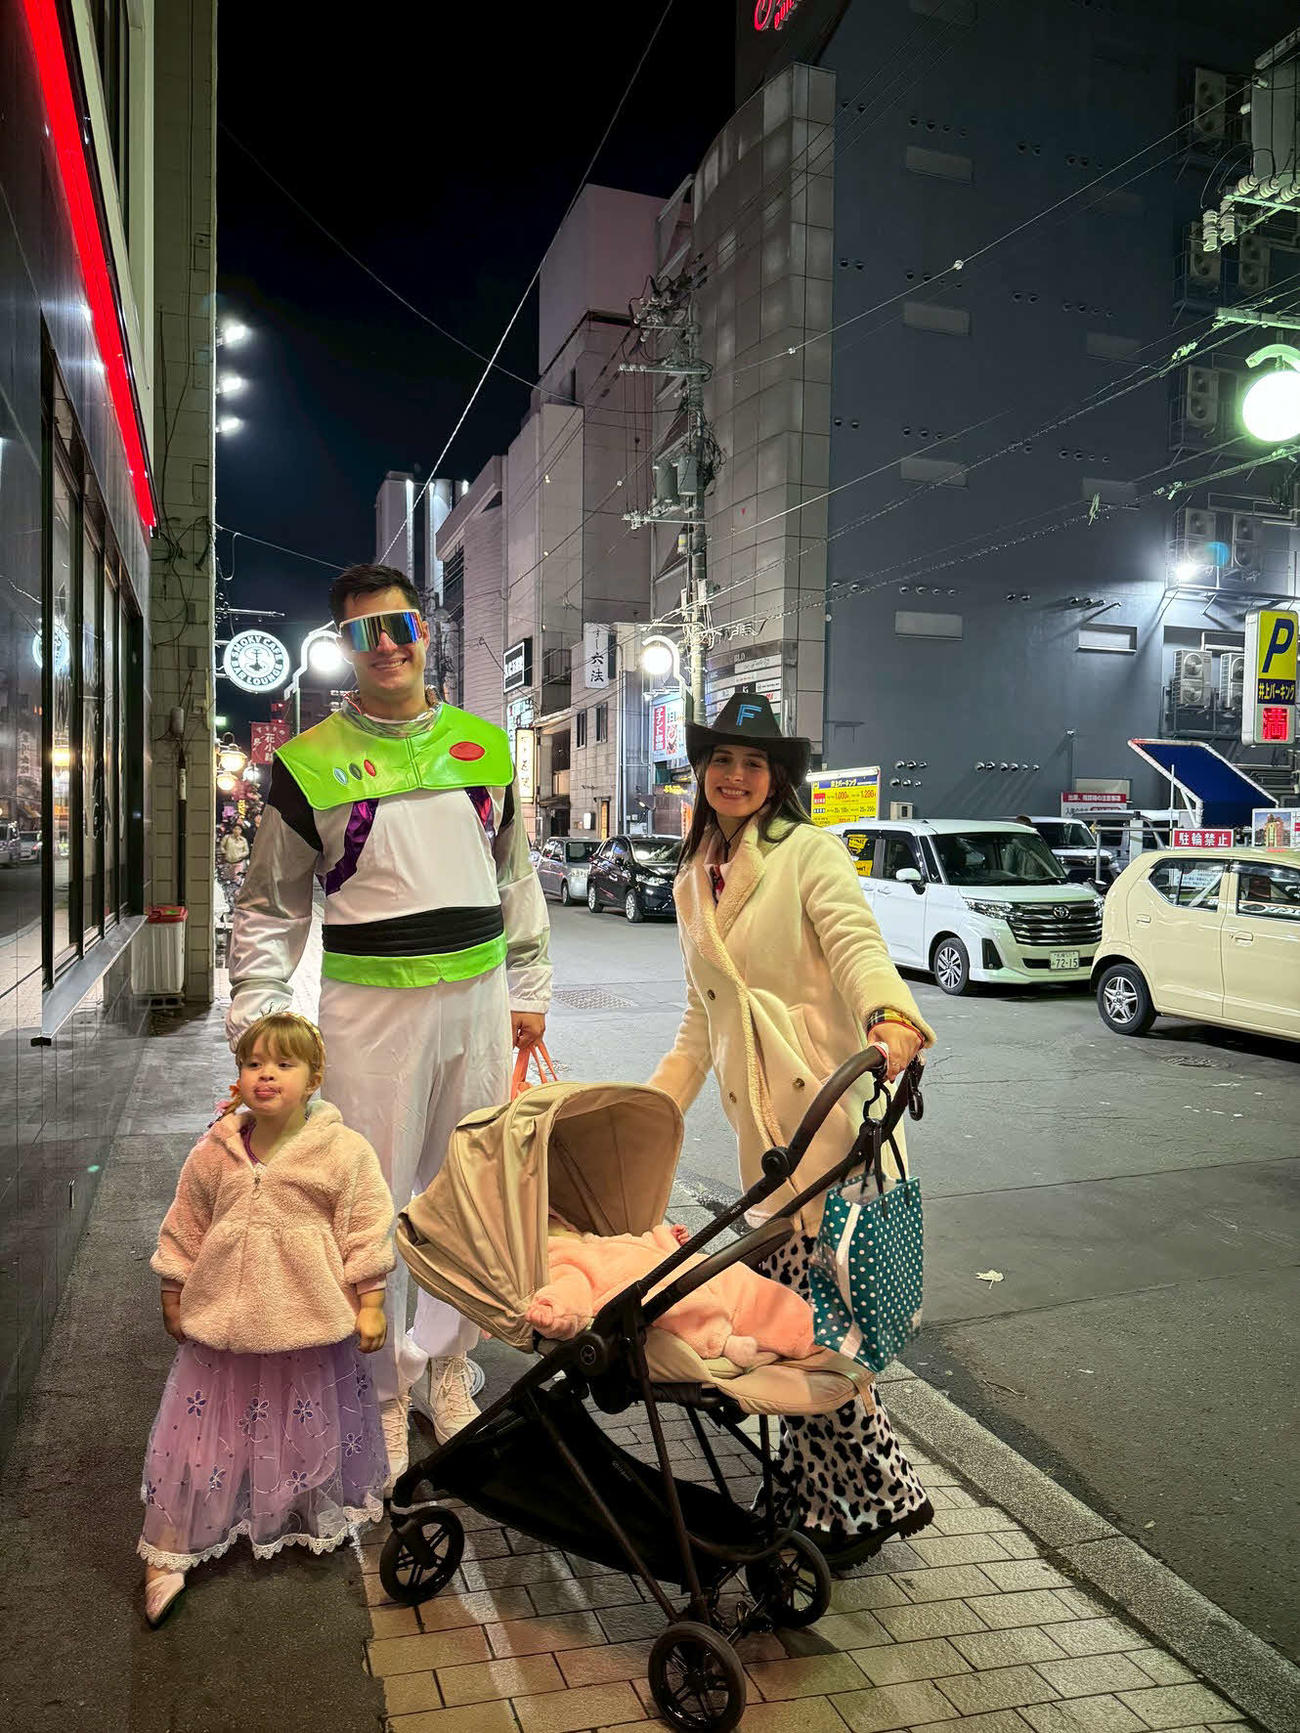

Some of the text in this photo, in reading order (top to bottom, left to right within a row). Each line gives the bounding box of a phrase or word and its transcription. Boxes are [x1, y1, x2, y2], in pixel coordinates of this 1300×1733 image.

[230, 634, 284, 661] SMOKY CAFE
[1262, 618, 1295, 673] P
[230, 660, 284, 686] BAR LOUNGE
[1258, 682, 1295, 700] 井上パーキング
[736, 703, 763, 727] F
[1179, 832, 1229, 847] 駐輪禁止
